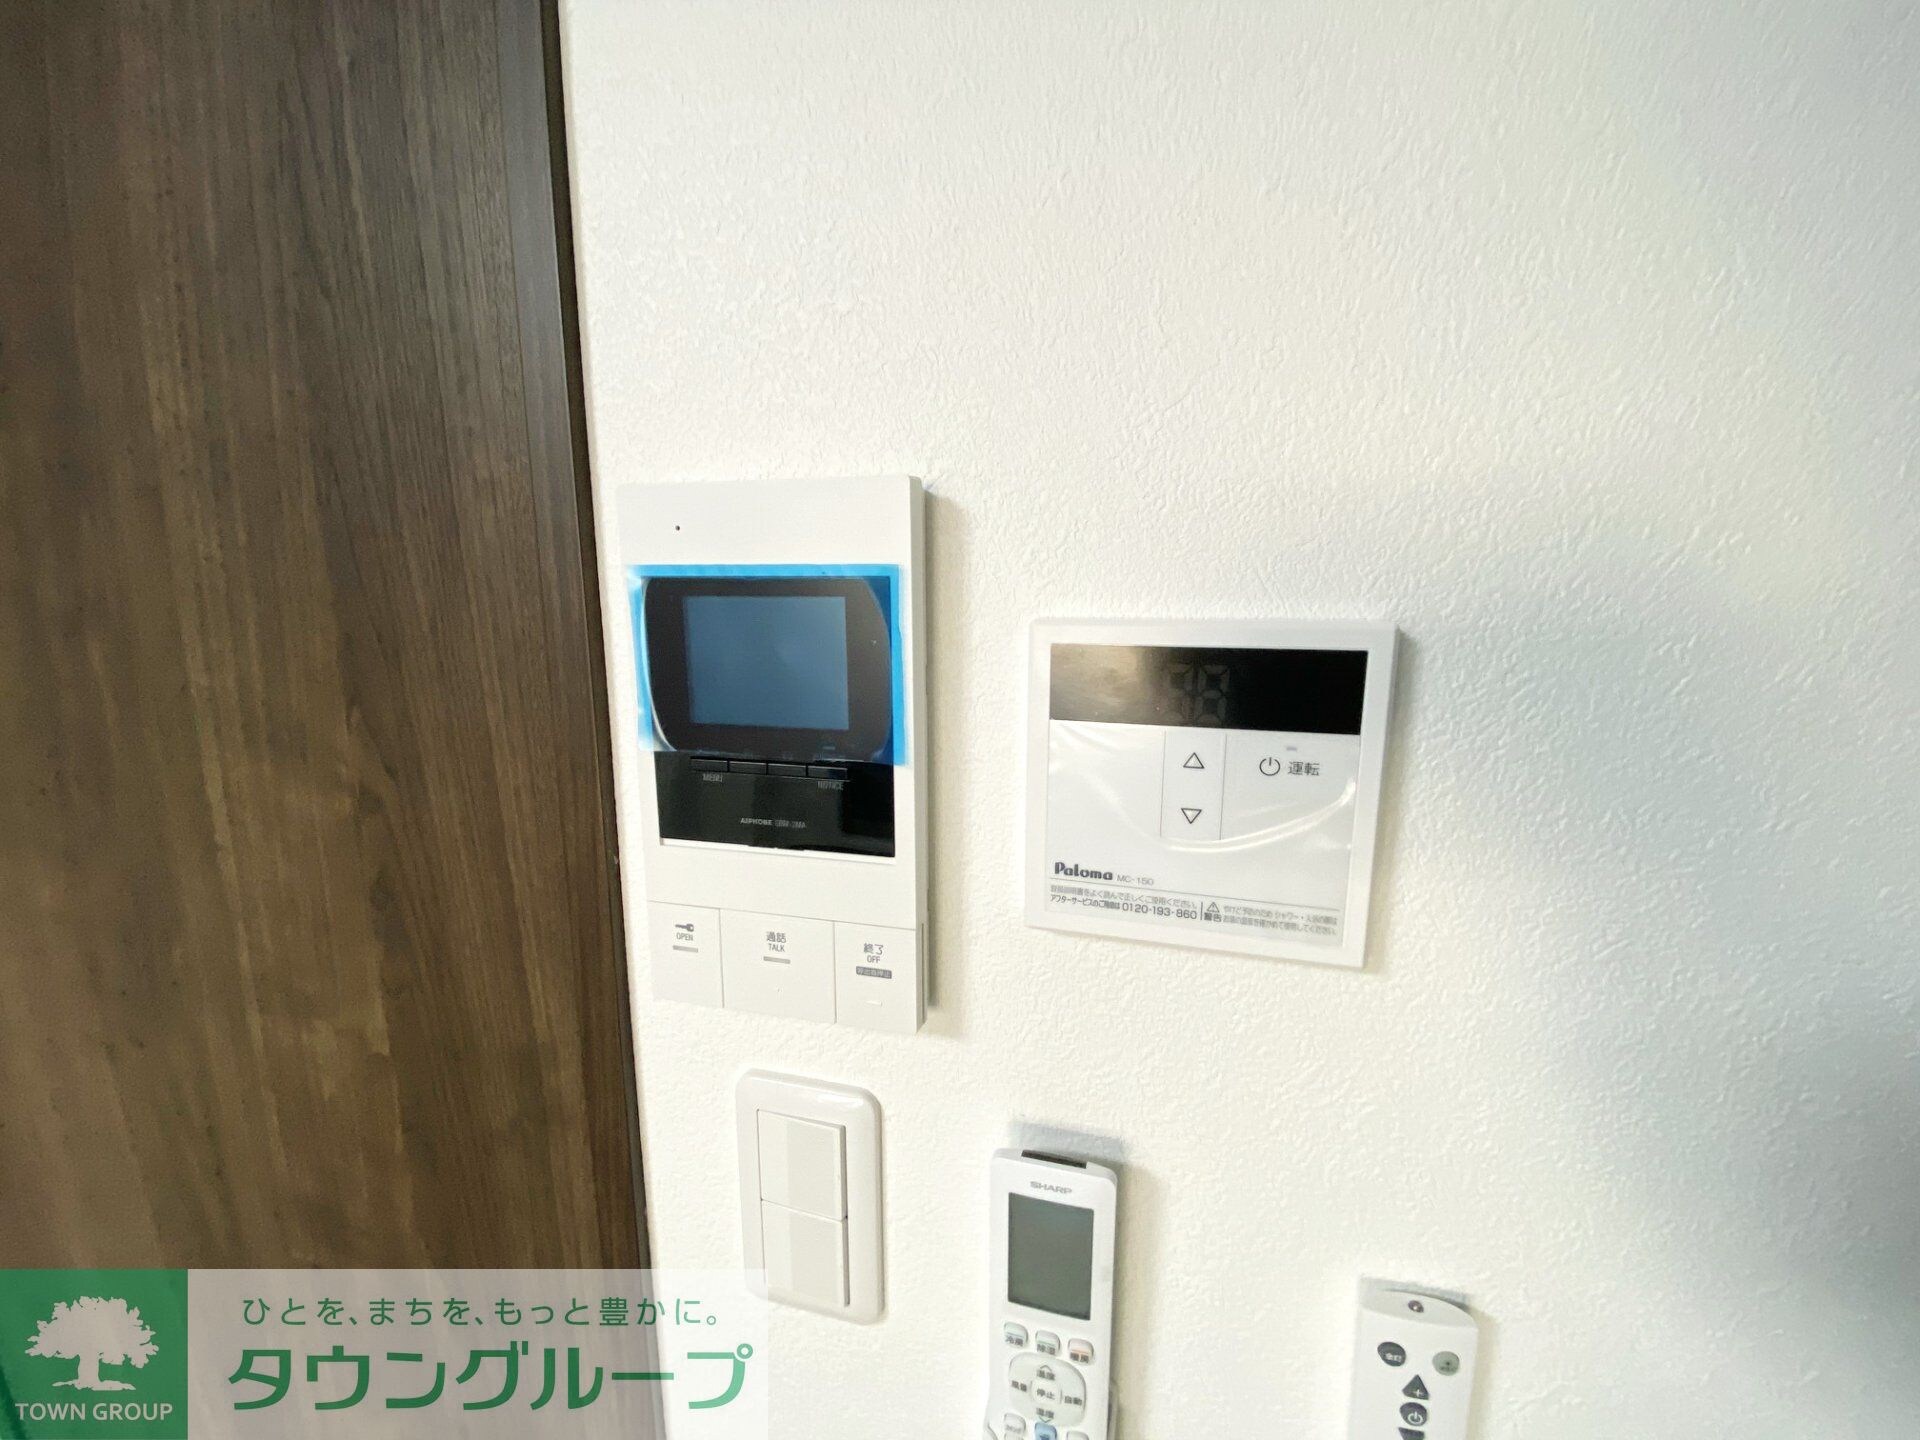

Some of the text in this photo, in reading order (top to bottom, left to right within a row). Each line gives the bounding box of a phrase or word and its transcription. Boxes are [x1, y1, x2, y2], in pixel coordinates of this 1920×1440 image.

[1287, 761, 1320, 777] 運転
[702, 773, 723, 783] MENU
[1054, 861, 1154, 886] Paloma MC-150
[675, 932, 694, 942] OPEN
[766, 931, 787, 944] 通話
[768, 943, 786, 953] TALK
[863, 942, 884, 955] 終了
[867, 955, 881, 964] OFF
[1029, 1181, 1073, 1194] SHARP
